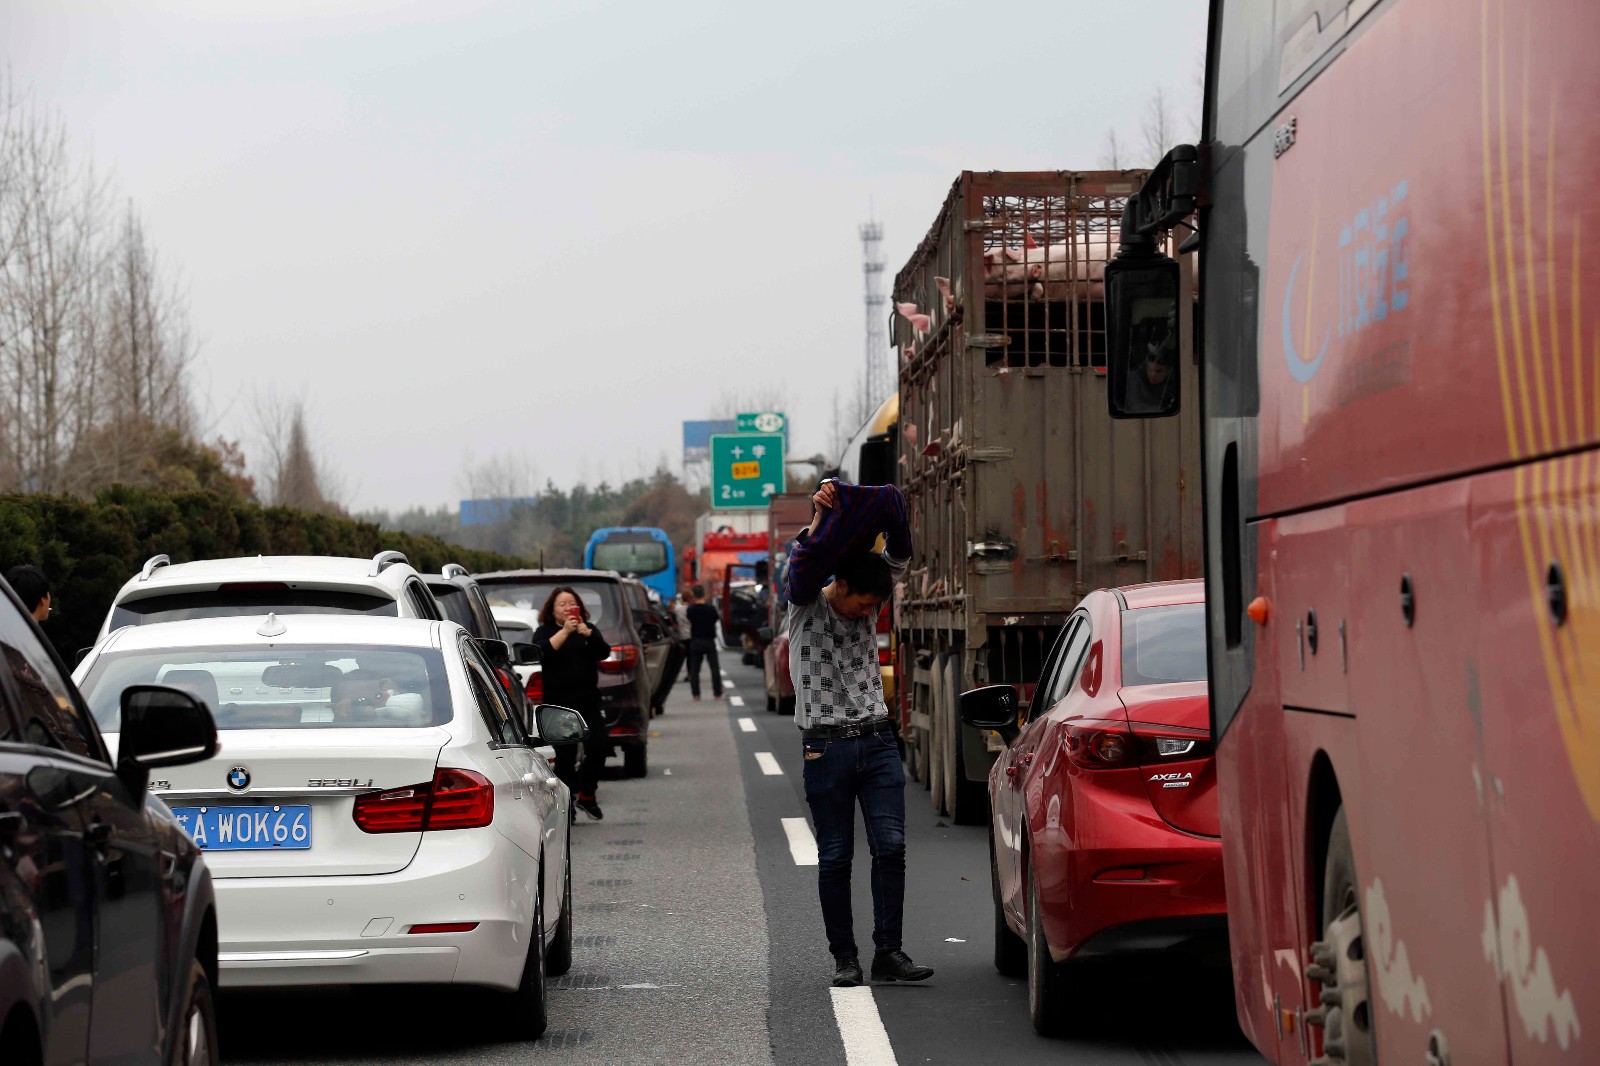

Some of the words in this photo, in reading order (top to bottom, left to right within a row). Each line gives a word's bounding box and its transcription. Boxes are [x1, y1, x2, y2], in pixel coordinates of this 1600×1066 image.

[721, 484, 731, 499] 2
[1148, 772, 1193, 781] AXELA
[307, 778, 374, 788] 328Li
